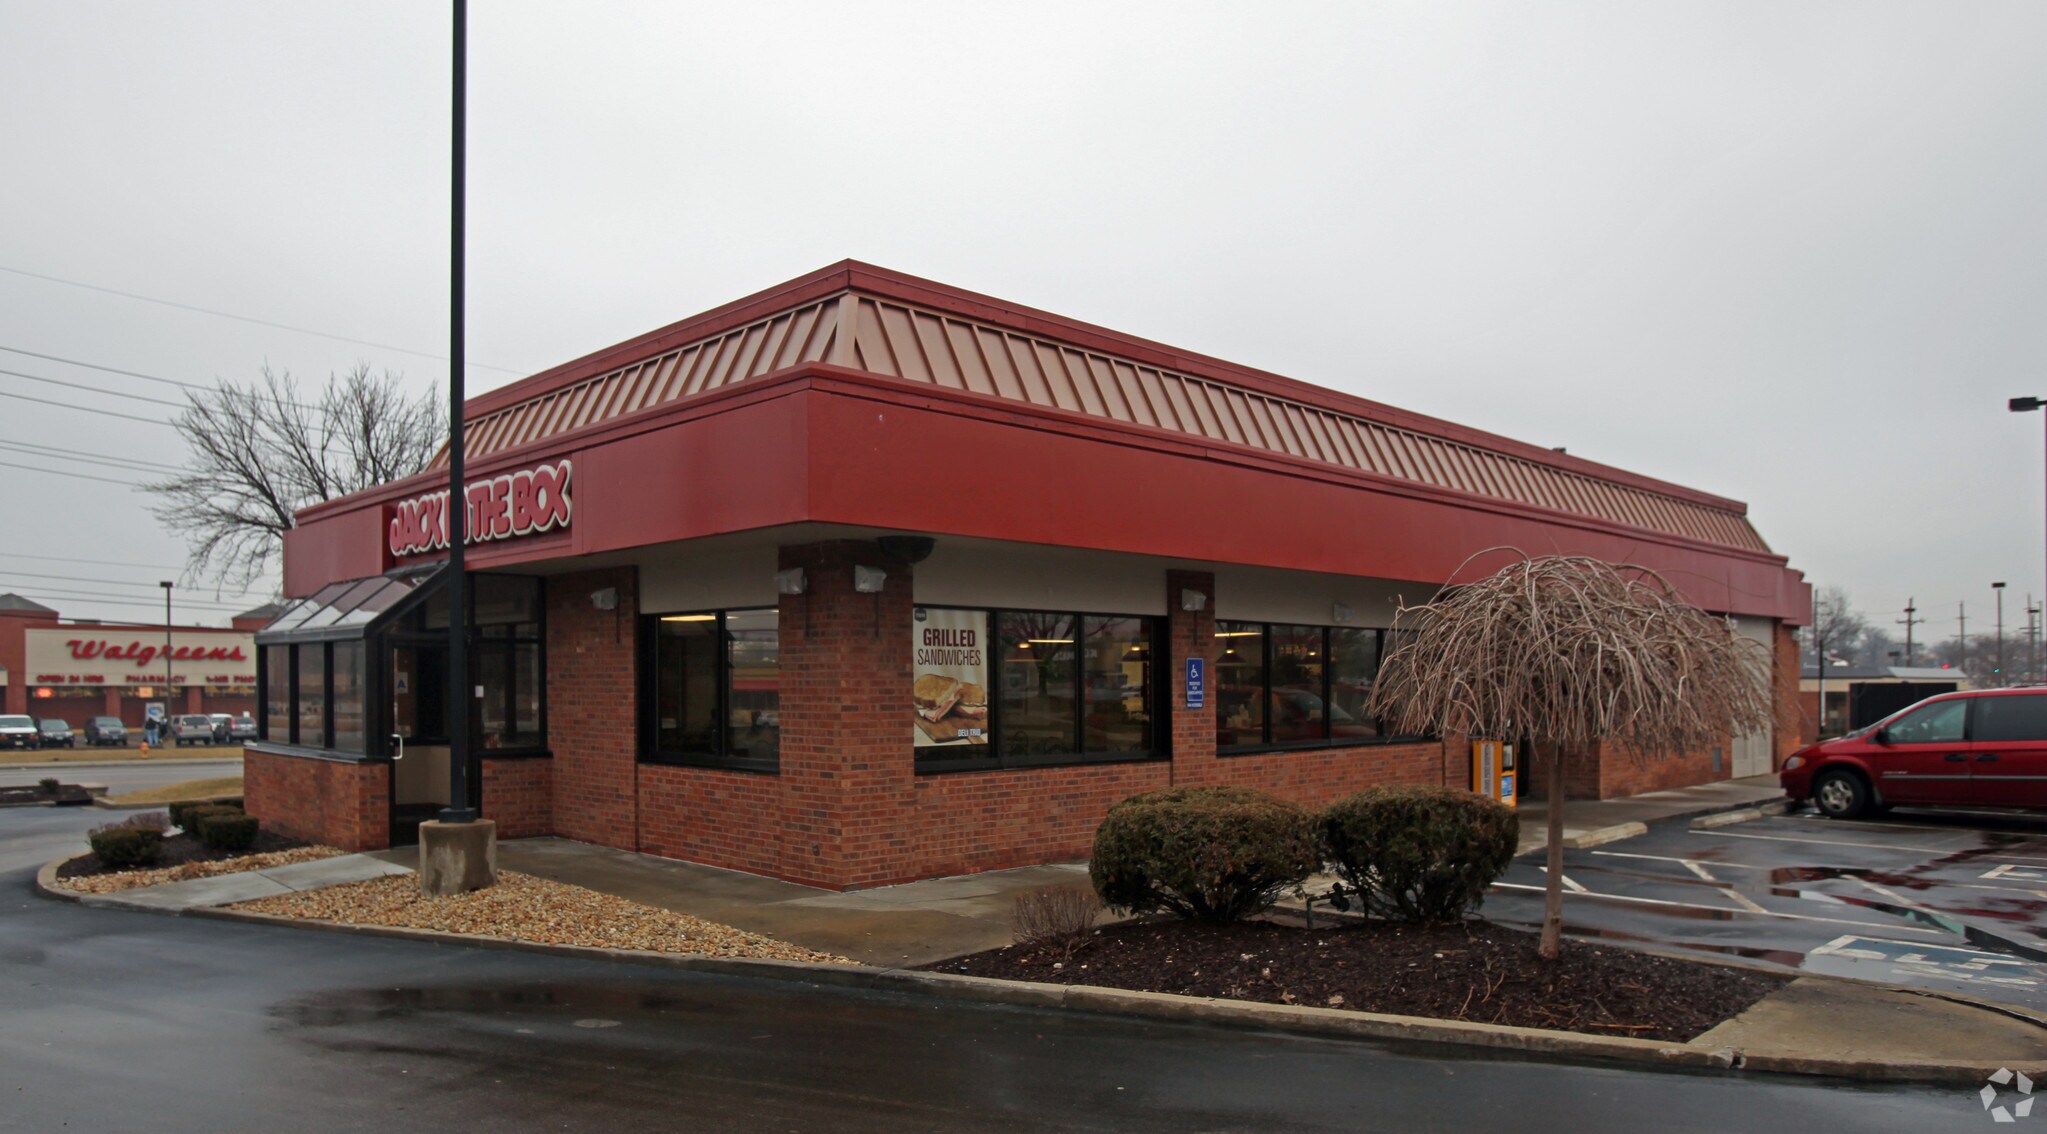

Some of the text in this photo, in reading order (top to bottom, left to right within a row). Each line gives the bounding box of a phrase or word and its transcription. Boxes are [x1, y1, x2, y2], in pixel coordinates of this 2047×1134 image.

[390, 495, 444, 553] JACK
[467, 477, 512, 541] THE
[512, 462, 571, 531] BOX
[923, 628, 976, 648] GRILLED
[66, 639, 248, 668] Walgreens
[917, 648, 981, 666] SANDWICHES
[37, 675, 105, 683] OPEN 24 HRS
